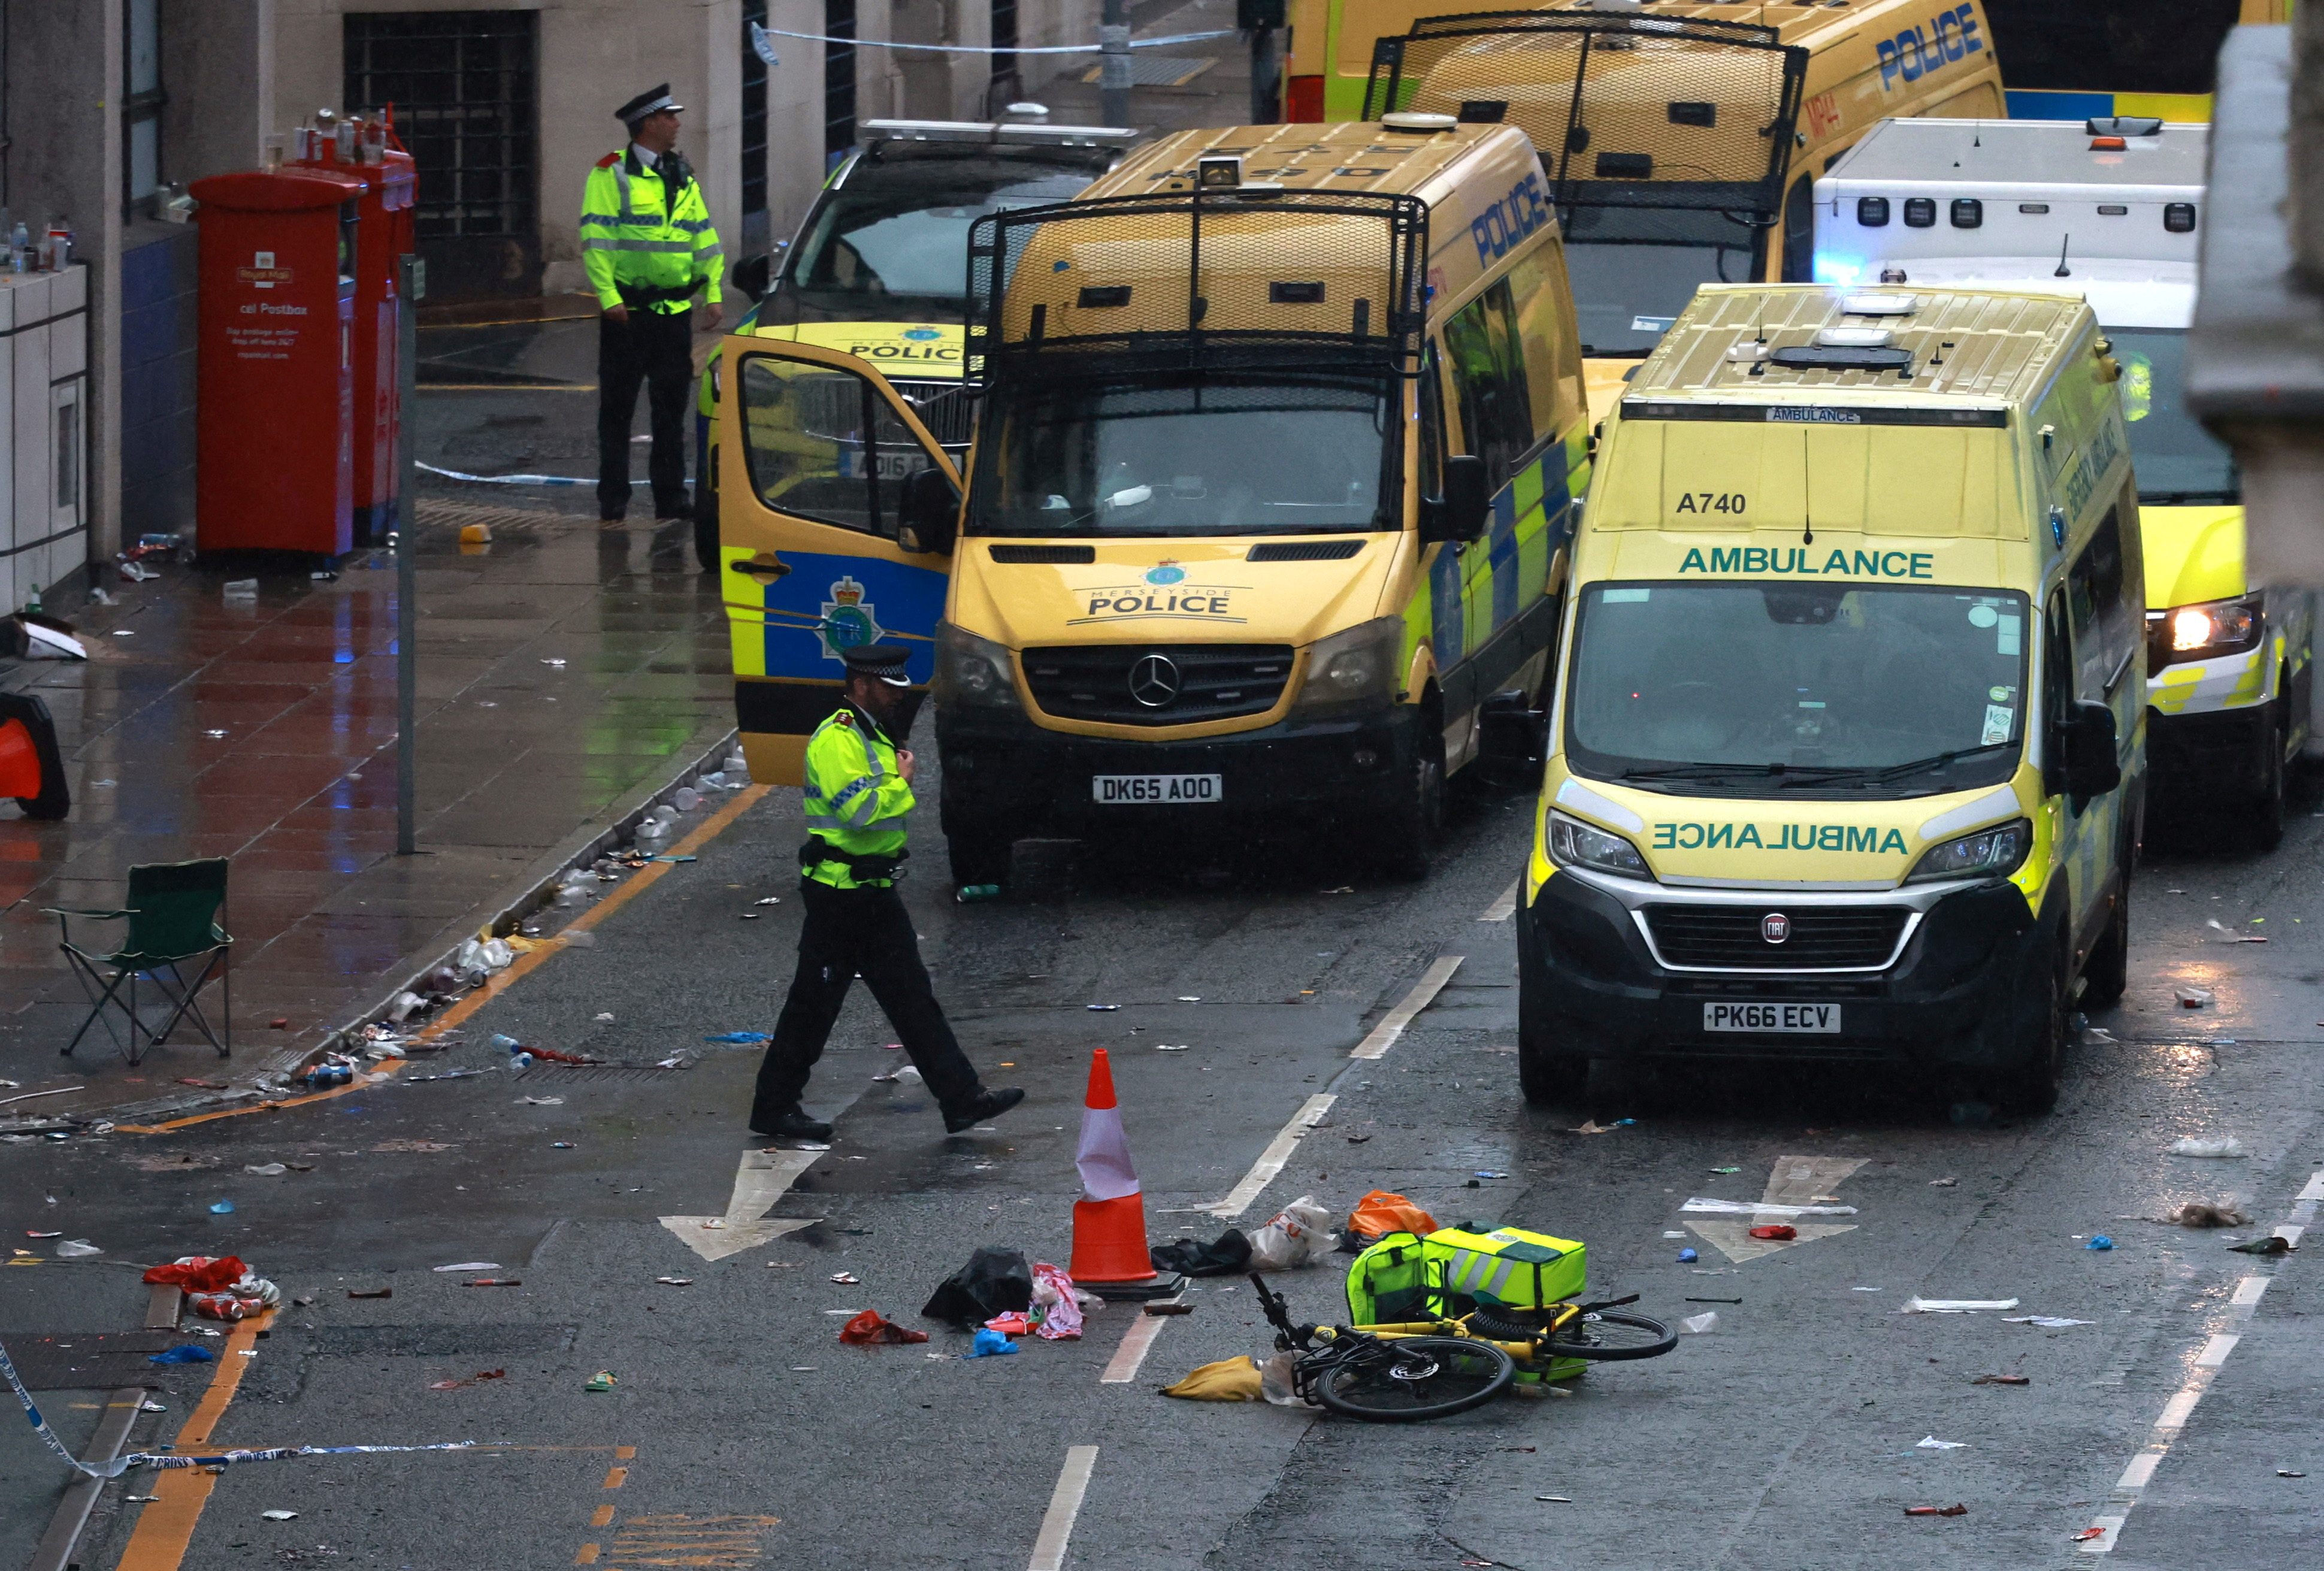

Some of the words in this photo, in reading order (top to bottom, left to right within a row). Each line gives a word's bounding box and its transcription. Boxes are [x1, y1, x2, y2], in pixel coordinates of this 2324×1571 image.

[1875, 2, 1983, 92] POLICE
[1471, 171, 1547, 270] POLICE
[850, 346, 964, 360] POLIC
[1773, 407, 1854, 422] AMBULANCE
[1676, 493, 1746, 514] A740
[1678, 547, 1934, 579] AMBULANCE
[1091, 588, 1231, 598] MERSEYSIDE
[1089, 595, 1230, 615] POLICE
[1103, 779, 1161, 800] DK65
[1767, 922, 1785, 936] FIAT
[1714, 1006, 1777, 1027] PK66
[1783, 1006, 1830, 1028] ECV
